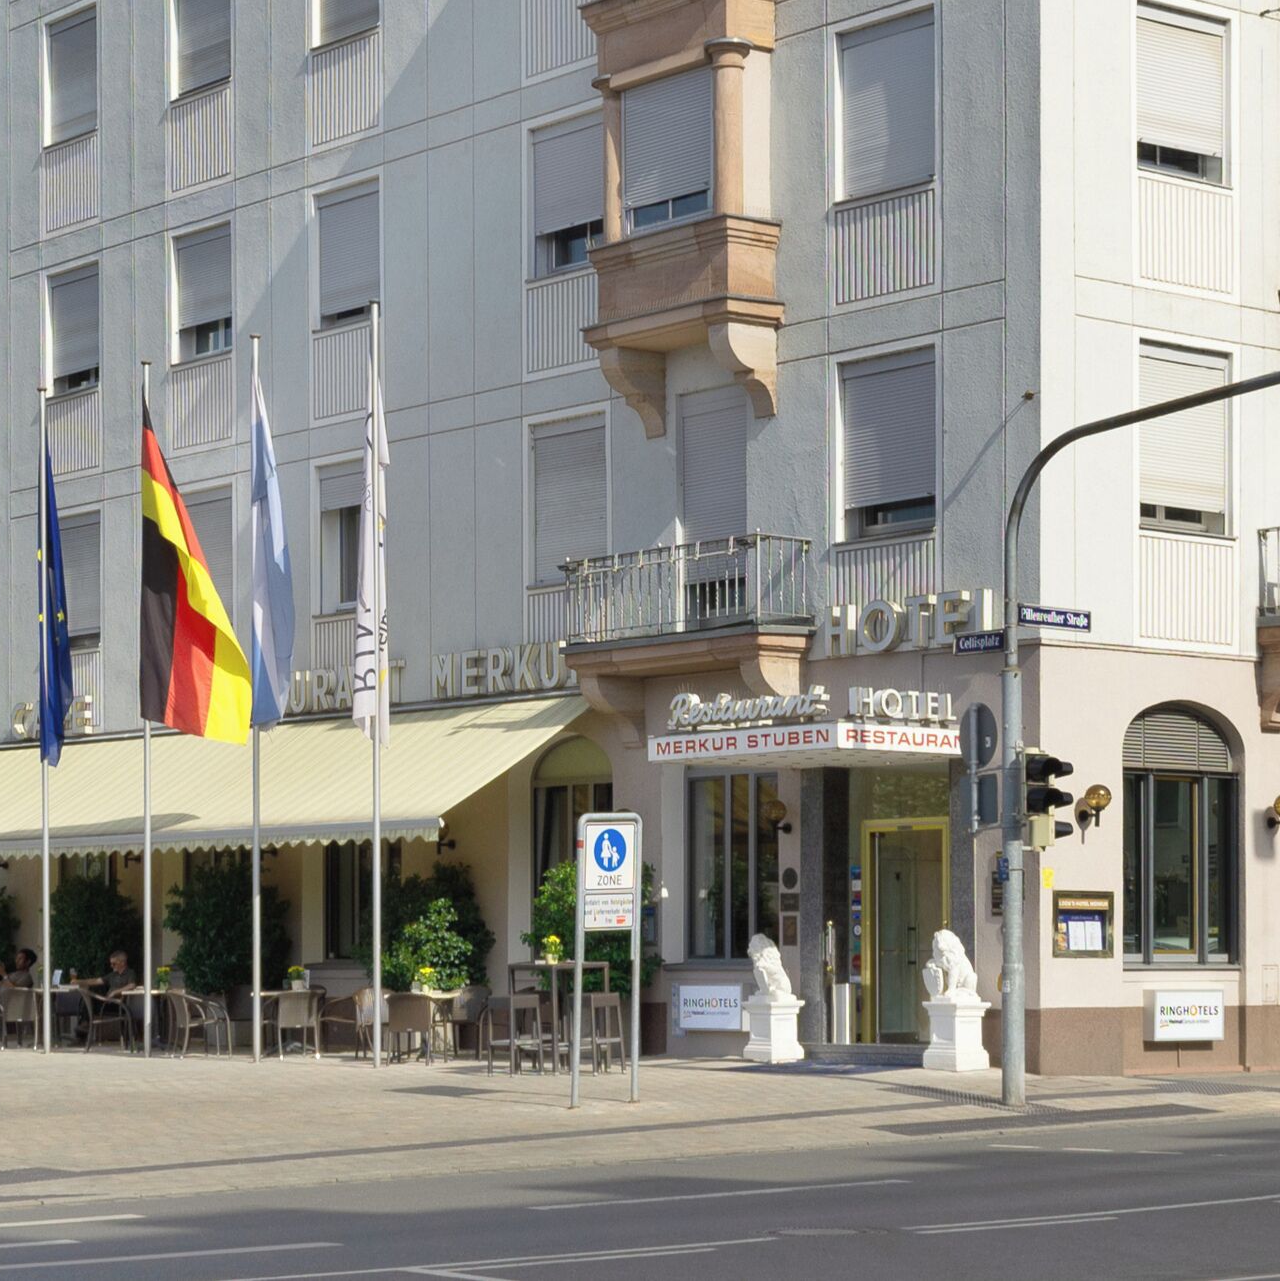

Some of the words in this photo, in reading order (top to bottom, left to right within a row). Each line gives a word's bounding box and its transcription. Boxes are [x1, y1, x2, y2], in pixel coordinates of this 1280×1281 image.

[431, 641, 578, 699] MERKU
[667, 685, 825, 729] Restaurant
[849, 686, 957, 721] HOTEL
[656, 736, 738, 756] MERKUR
[747, 728, 830, 749] STUBEN
[597, 874, 623, 887] ZONE
[683, 997, 738, 1008] RINGHOTELS
[1160, 1004, 1219, 1016] RINGHOTELS
